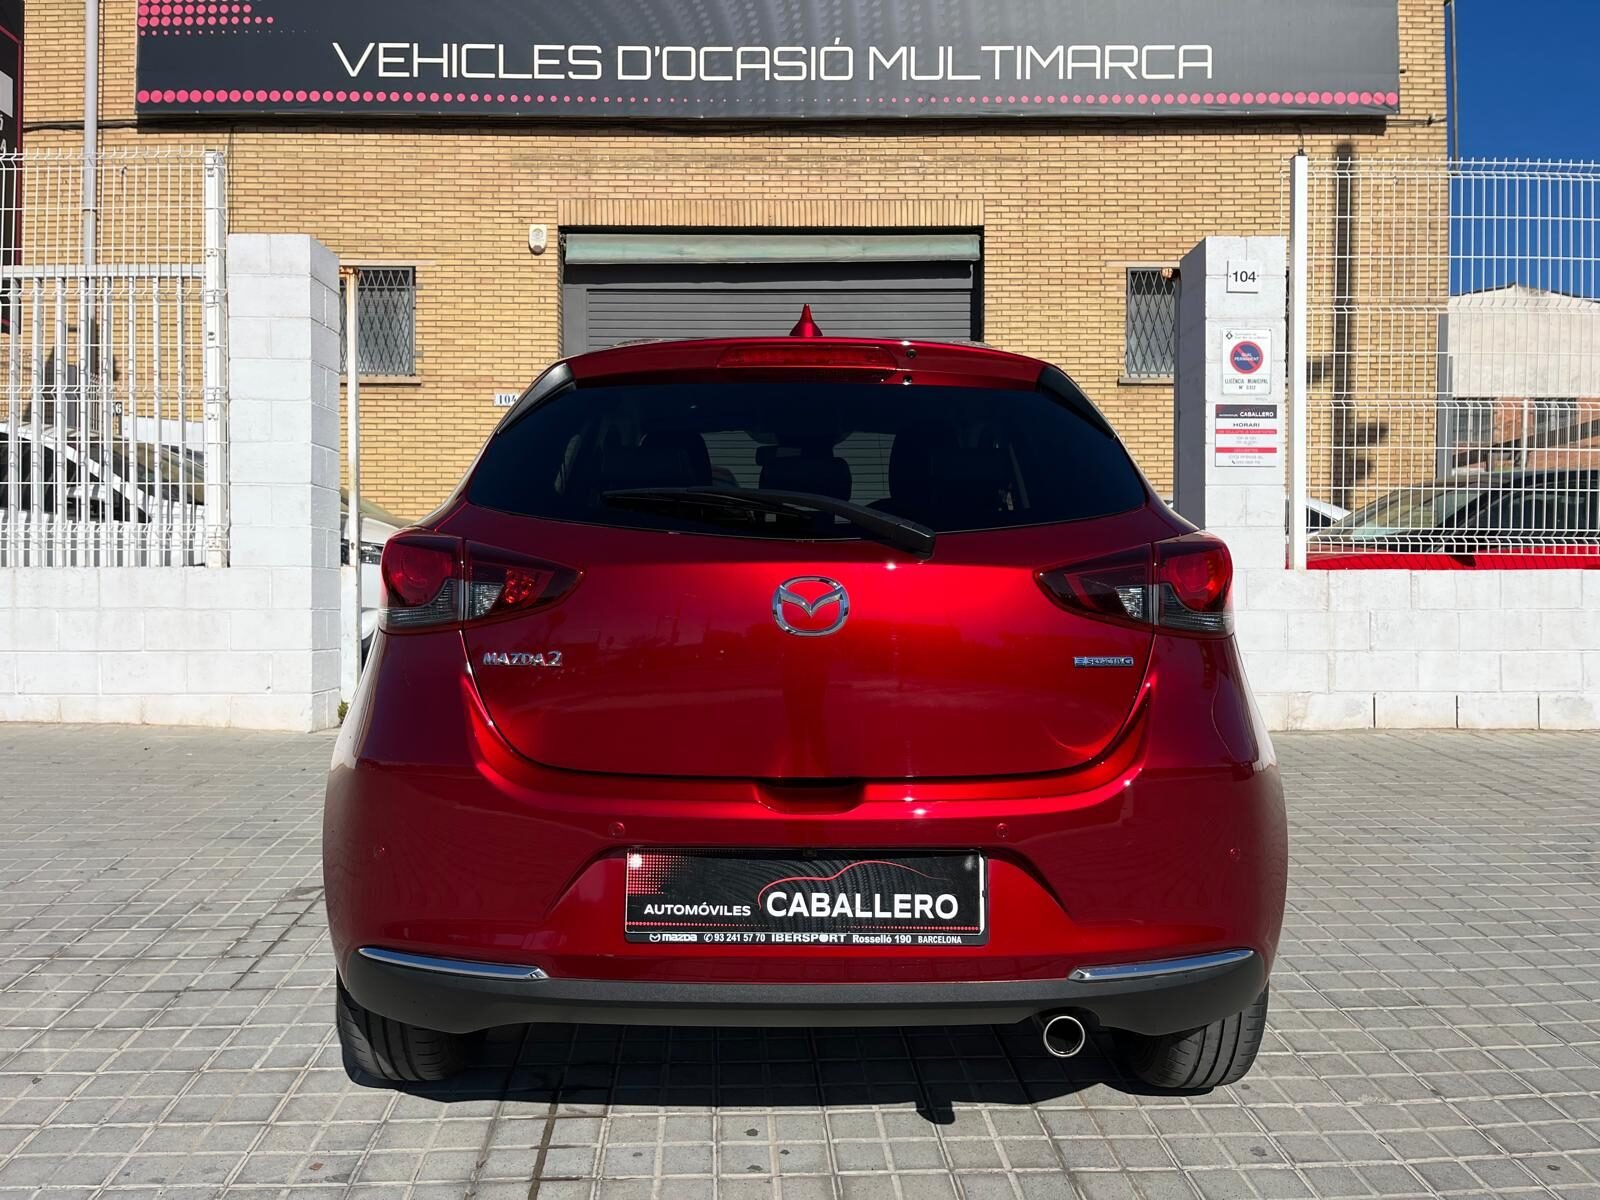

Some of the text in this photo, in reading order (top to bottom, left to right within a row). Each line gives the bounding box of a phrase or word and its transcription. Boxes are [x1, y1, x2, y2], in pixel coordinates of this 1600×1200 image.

[332, 37, 1213, 81] VEHICLES D'OCASIÓ MULTIMARCA
[1232, 270, 1257, 283] 104
[643, 891, 959, 920] AUTOMÓVILES CABALLERO
[661, 933, 698, 942] mazda
[713, 933, 725, 942] 93
[726, 933, 741, 942] 241
[743, 933, 753, 942] 57
[755, 933, 766, 942] 70
[771, 933, 847, 943] IBERSPORT
[894, 934, 912, 943] 190
[917, 935, 962, 944] BARCELONA
